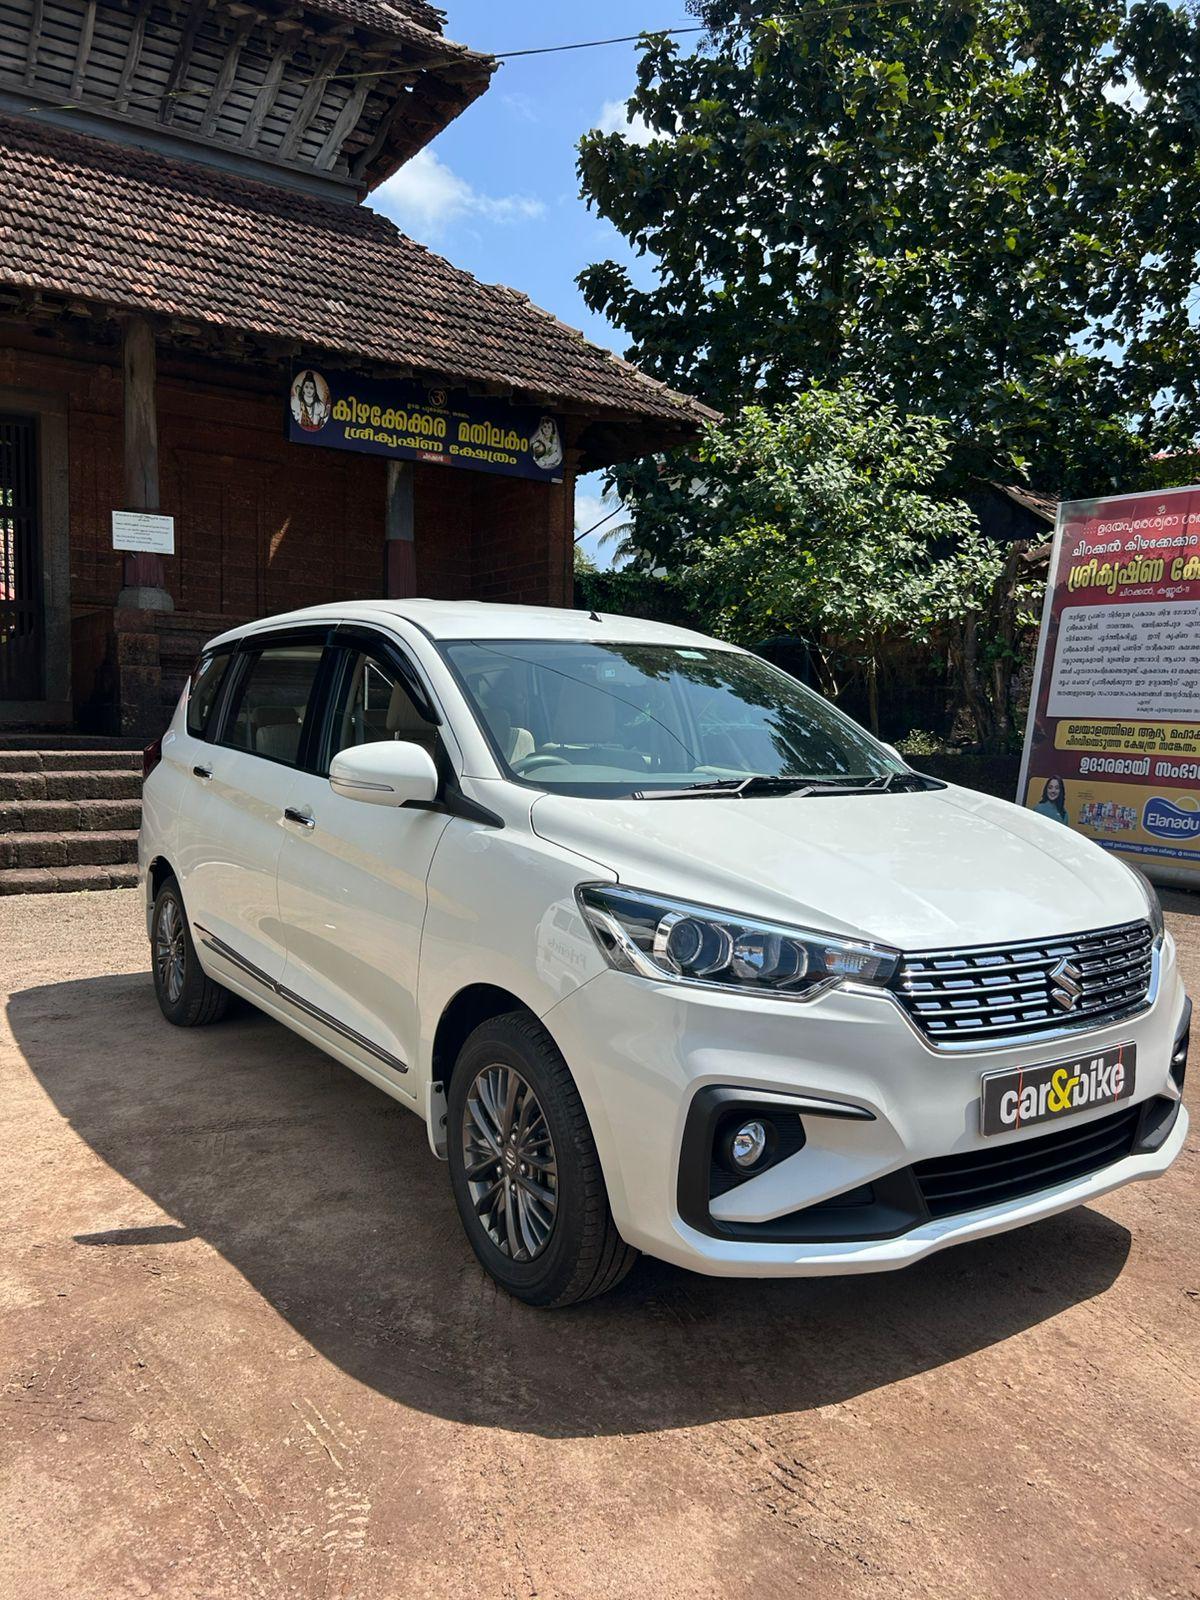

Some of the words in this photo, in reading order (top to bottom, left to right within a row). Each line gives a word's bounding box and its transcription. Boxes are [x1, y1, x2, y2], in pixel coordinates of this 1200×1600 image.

[332, 396, 446, 438] കിഴക്കേക്കര
[458, 420, 528, 453] മതിലകം
[344, 426, 443, 453] ശ്രീകൃഷ്ണ
[449, 444, 518, 465] ക്ഷേത്രം
[1072, 540, 1121, 557] ചിറക്കൽ
[1124, 535, 1198, 552] കിഴക്കേക്കര
[1067, 554, 1165, 595] ശ്രീകൃഷ്ണ
[1068, 723, 1136, 738] മലയാളത്തിലെ
[1138, 726, 1166, 742] ആദ്യ
[1124, 740, 1156, 752] ക്ഷേത്ര
[1158, 742, 1196, 753] സങ്കേതം
[1080, 757, 1150, 776] ഉദാരമായി
[1147, 813, 1200, 831] Elanadu
[1000, 1058, 1125, 1124] car&bike
